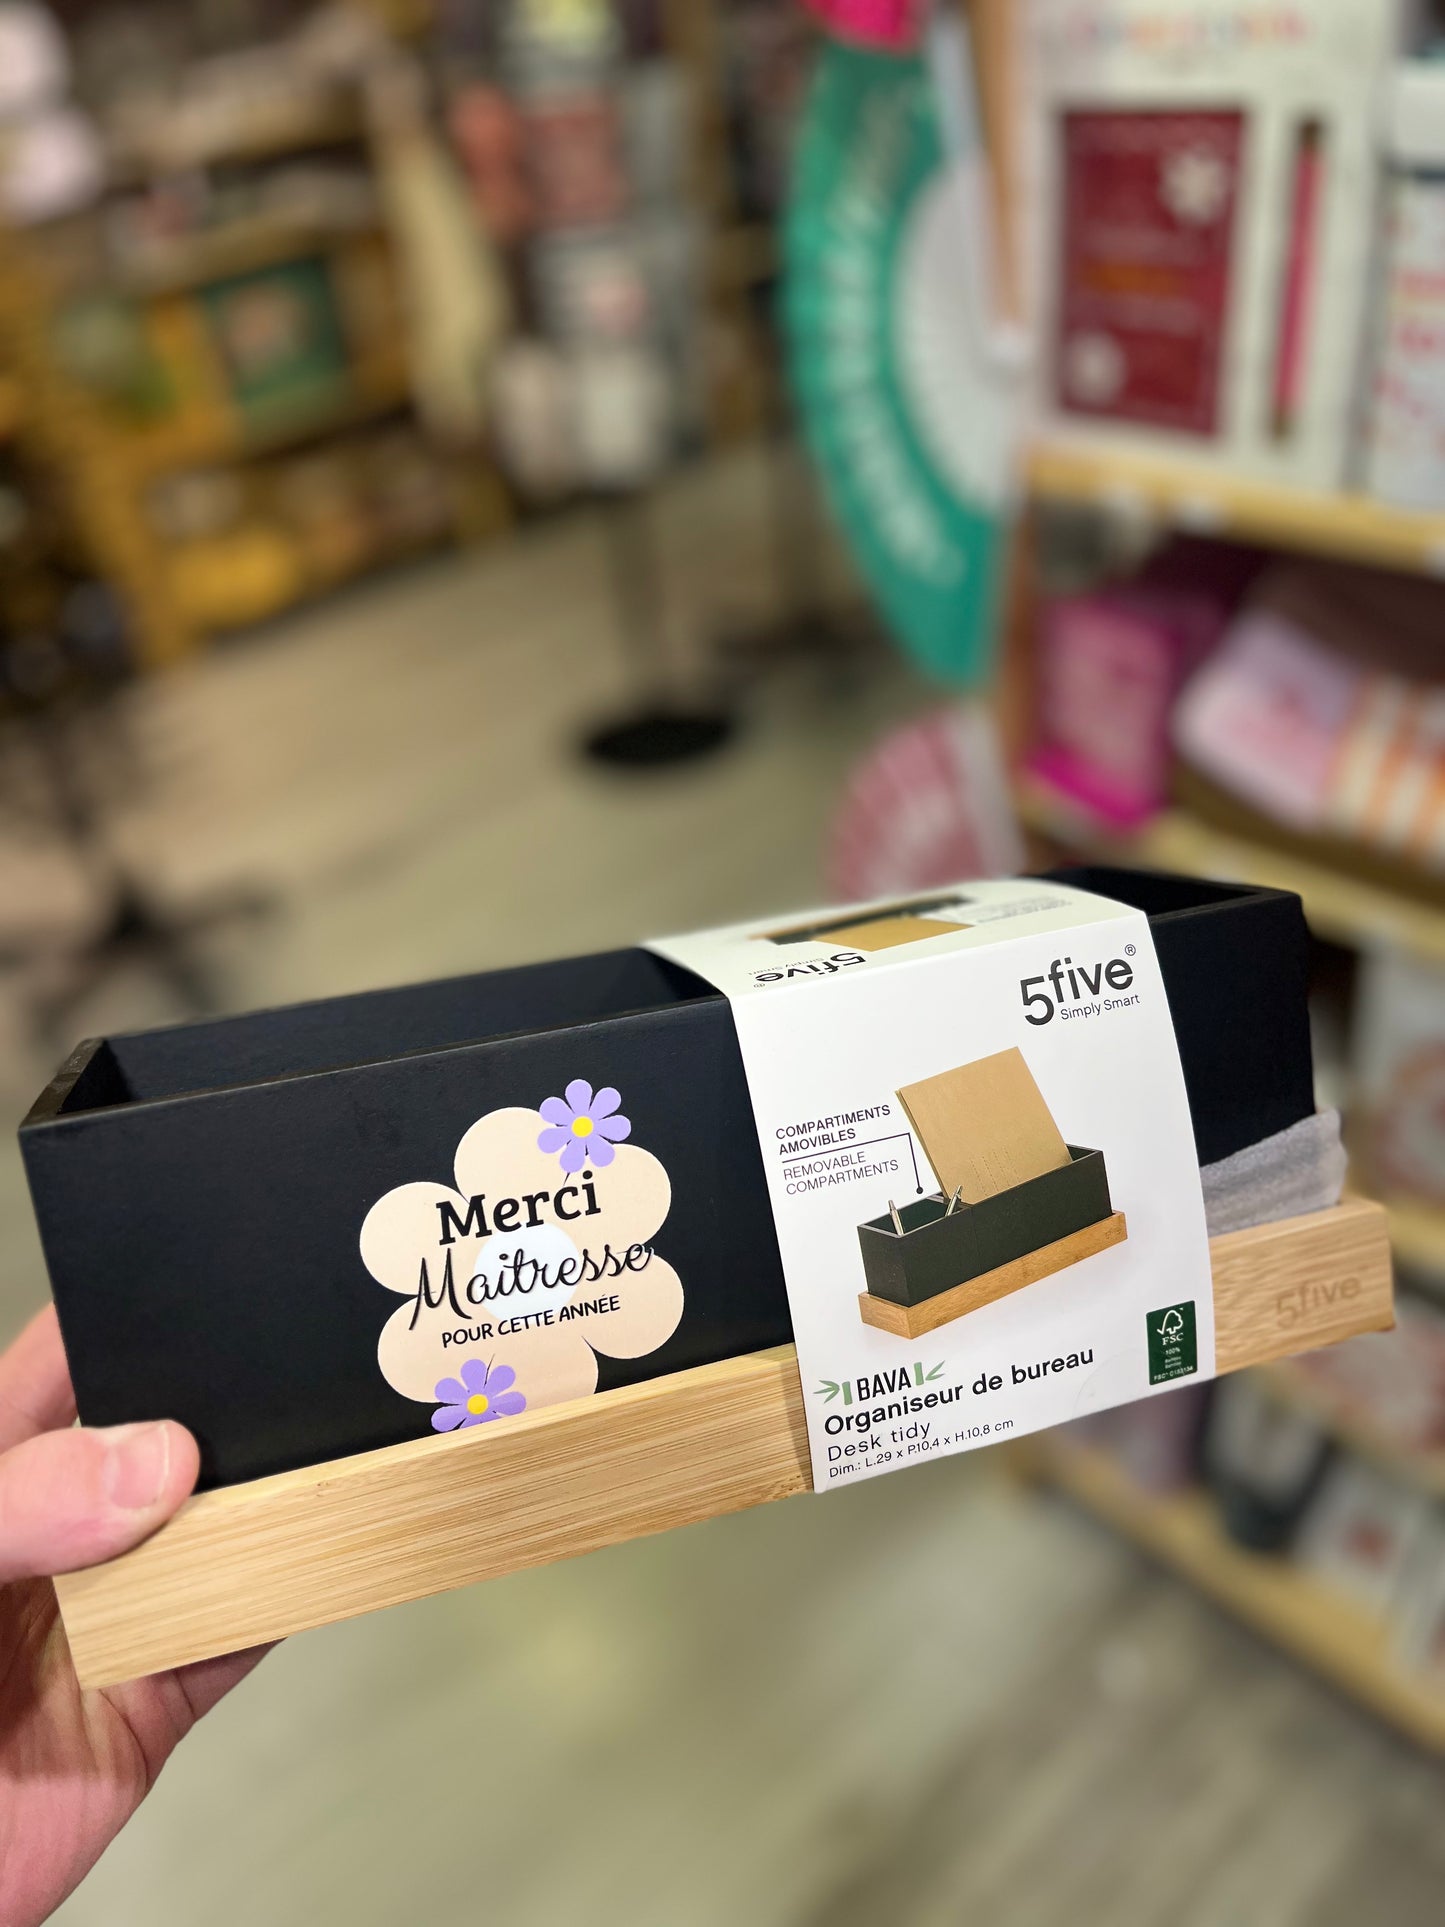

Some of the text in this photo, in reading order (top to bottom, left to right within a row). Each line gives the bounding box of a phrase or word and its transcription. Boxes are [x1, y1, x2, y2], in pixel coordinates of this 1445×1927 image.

[1060, 994, 1140, 1020] Simply Smart
[775, 1104, 891, 1139] COMPARTIMENTS
[779, 1128, 856, 1155] AMOVIBLES
[783, 1151, 867, 1181] REMOVABLE
[786, 1159, 899, 1195] COMPARTMENTS
[436, 1170, 601, 1245] Merci
[441, 1294, 621, 1348] POUR CETTE ANNÉE
[1162, 1332, 1184, 1346] FSC
[1165, 1347, 1181, 1355] 100%
[824, 1349, 1094, 1435] Organiseur de bureau
[857, 1367, 912, 1401] BAVA
[828, 1421, 931, 1462] Desk tidy
[829, 1418, 1014, 1478] Dim.: L.29 x P.10,4 x H.10,8 cm
